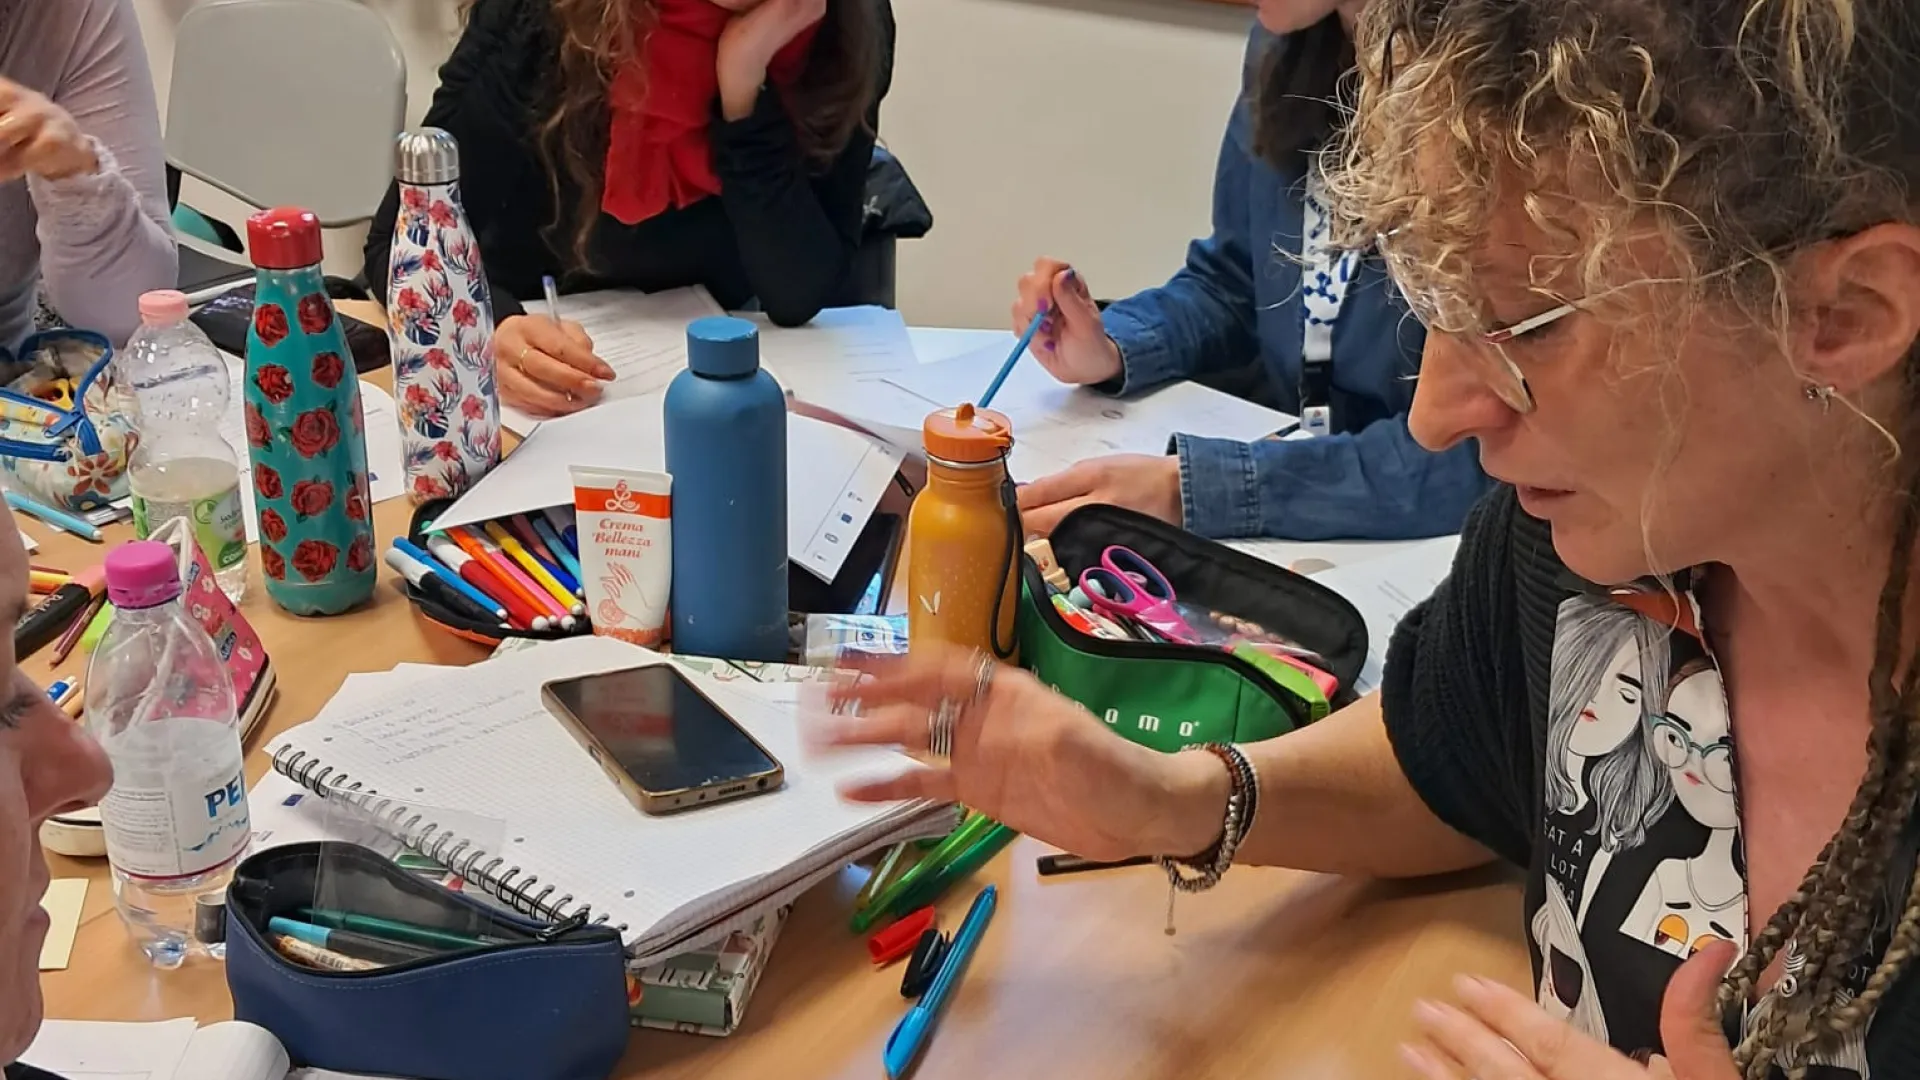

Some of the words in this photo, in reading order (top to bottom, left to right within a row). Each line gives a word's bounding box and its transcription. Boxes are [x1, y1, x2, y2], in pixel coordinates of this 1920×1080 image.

[599, 518, 644, 533] Crema
[593, 532, 652, 547] Bellezza
[604, 547, 641, 559] mani
[1571, 838, 1583, 857] A
